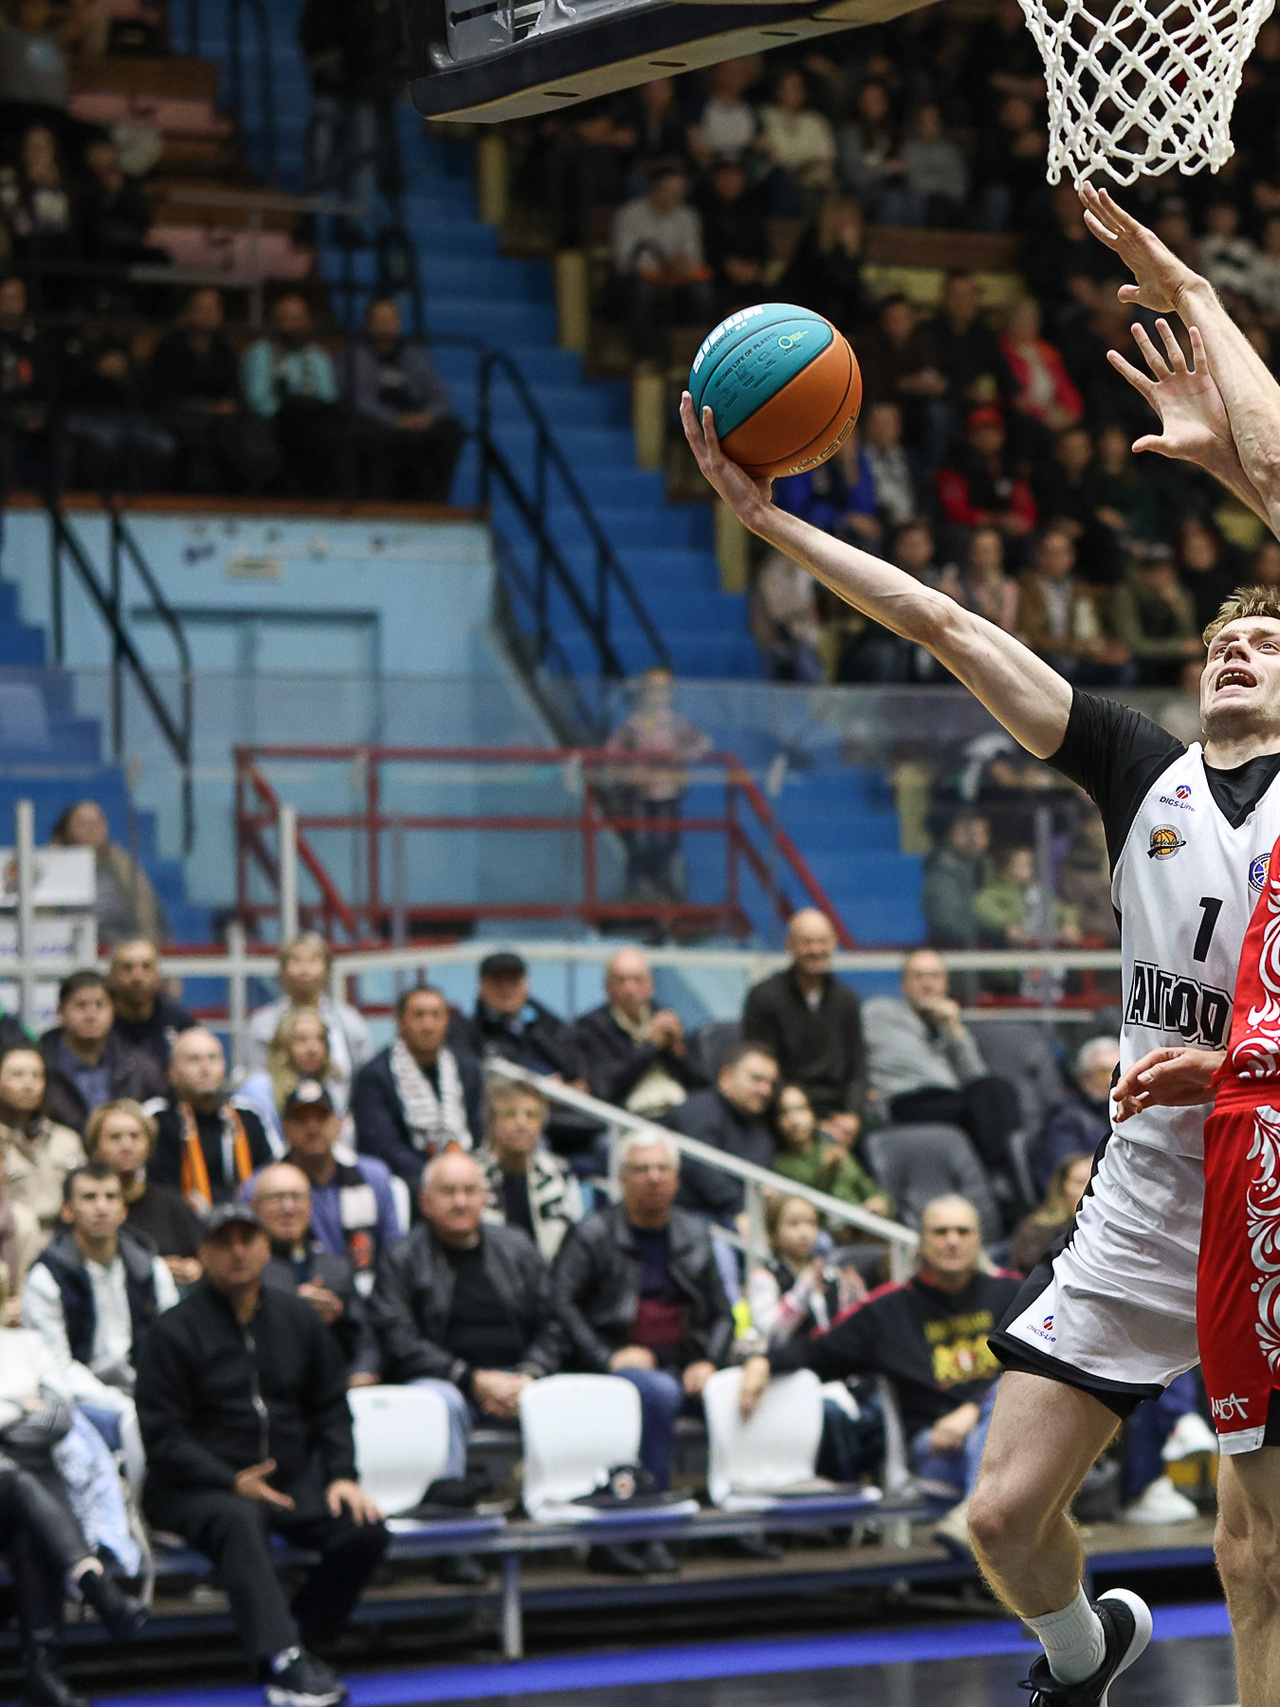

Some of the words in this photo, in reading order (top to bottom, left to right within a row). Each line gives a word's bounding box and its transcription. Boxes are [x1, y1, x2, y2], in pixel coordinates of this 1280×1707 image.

[733, 355, 746, 368] LIFE
[745, 348, 753, 358] OF
[753, 332, 778, 350] PLASTIC
[1193, 896, 1223, 963] 1
[1124, 960, 1234, 1050] AVTOD
